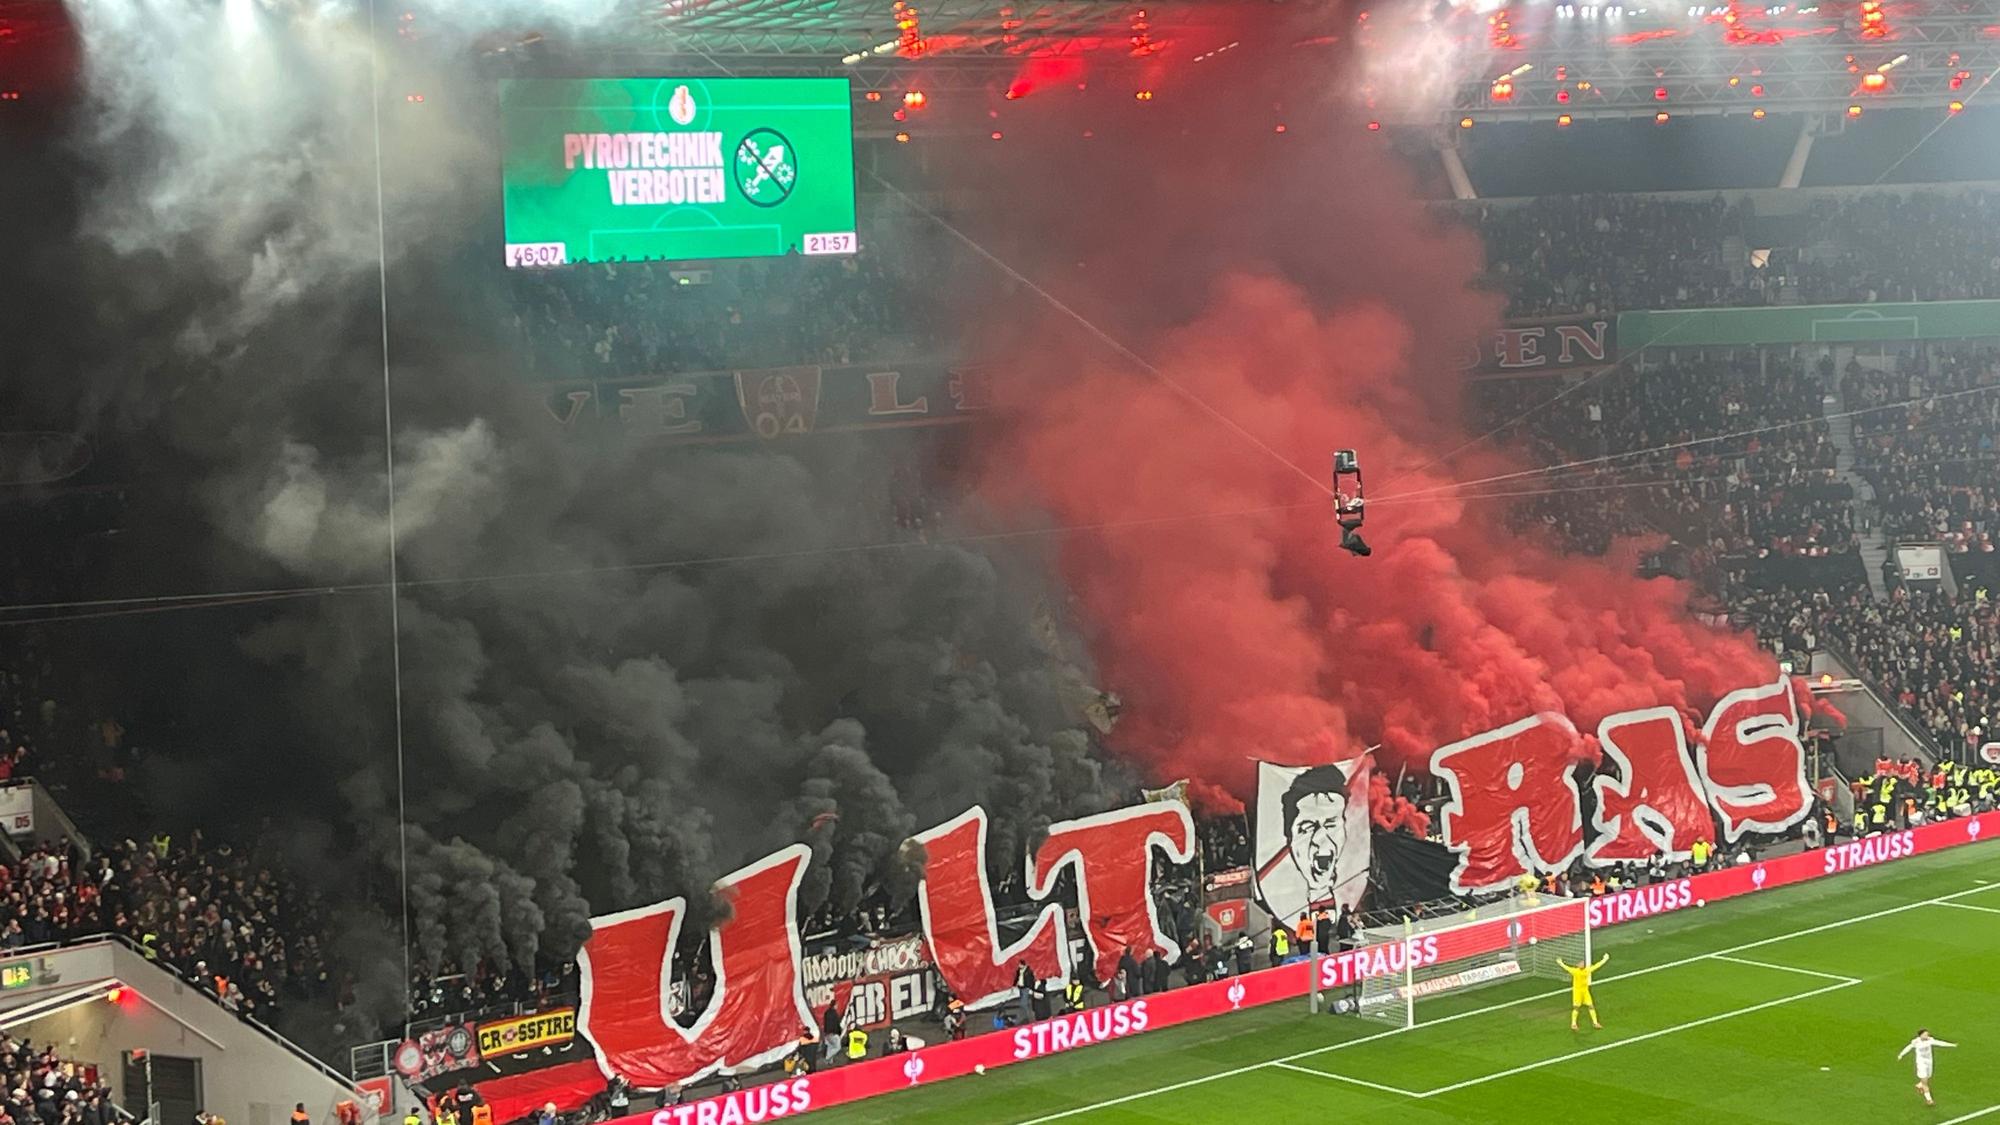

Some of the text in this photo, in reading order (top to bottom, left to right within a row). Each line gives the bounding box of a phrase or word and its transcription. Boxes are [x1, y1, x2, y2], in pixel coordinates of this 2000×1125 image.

[563, 131, 724, 170] PYROTECHNIK
[608, 167, 726, 206] VERBOTEN
[514, 245, 559, 263] 46:07
[810, 235, 850, 251] 21:57
[1824, 831, 1915, 874] STRAUSS
[1589, 879, 1693, 926] STRAUSS
[1320, 934, 1439, 987] STRAUSS
[480, 1014, 574, 1052] CROSSFIRE
[1013, 1001, 1149, 1060] STRAUSS
[652, 1077, 812, 1125] STRAUSS
